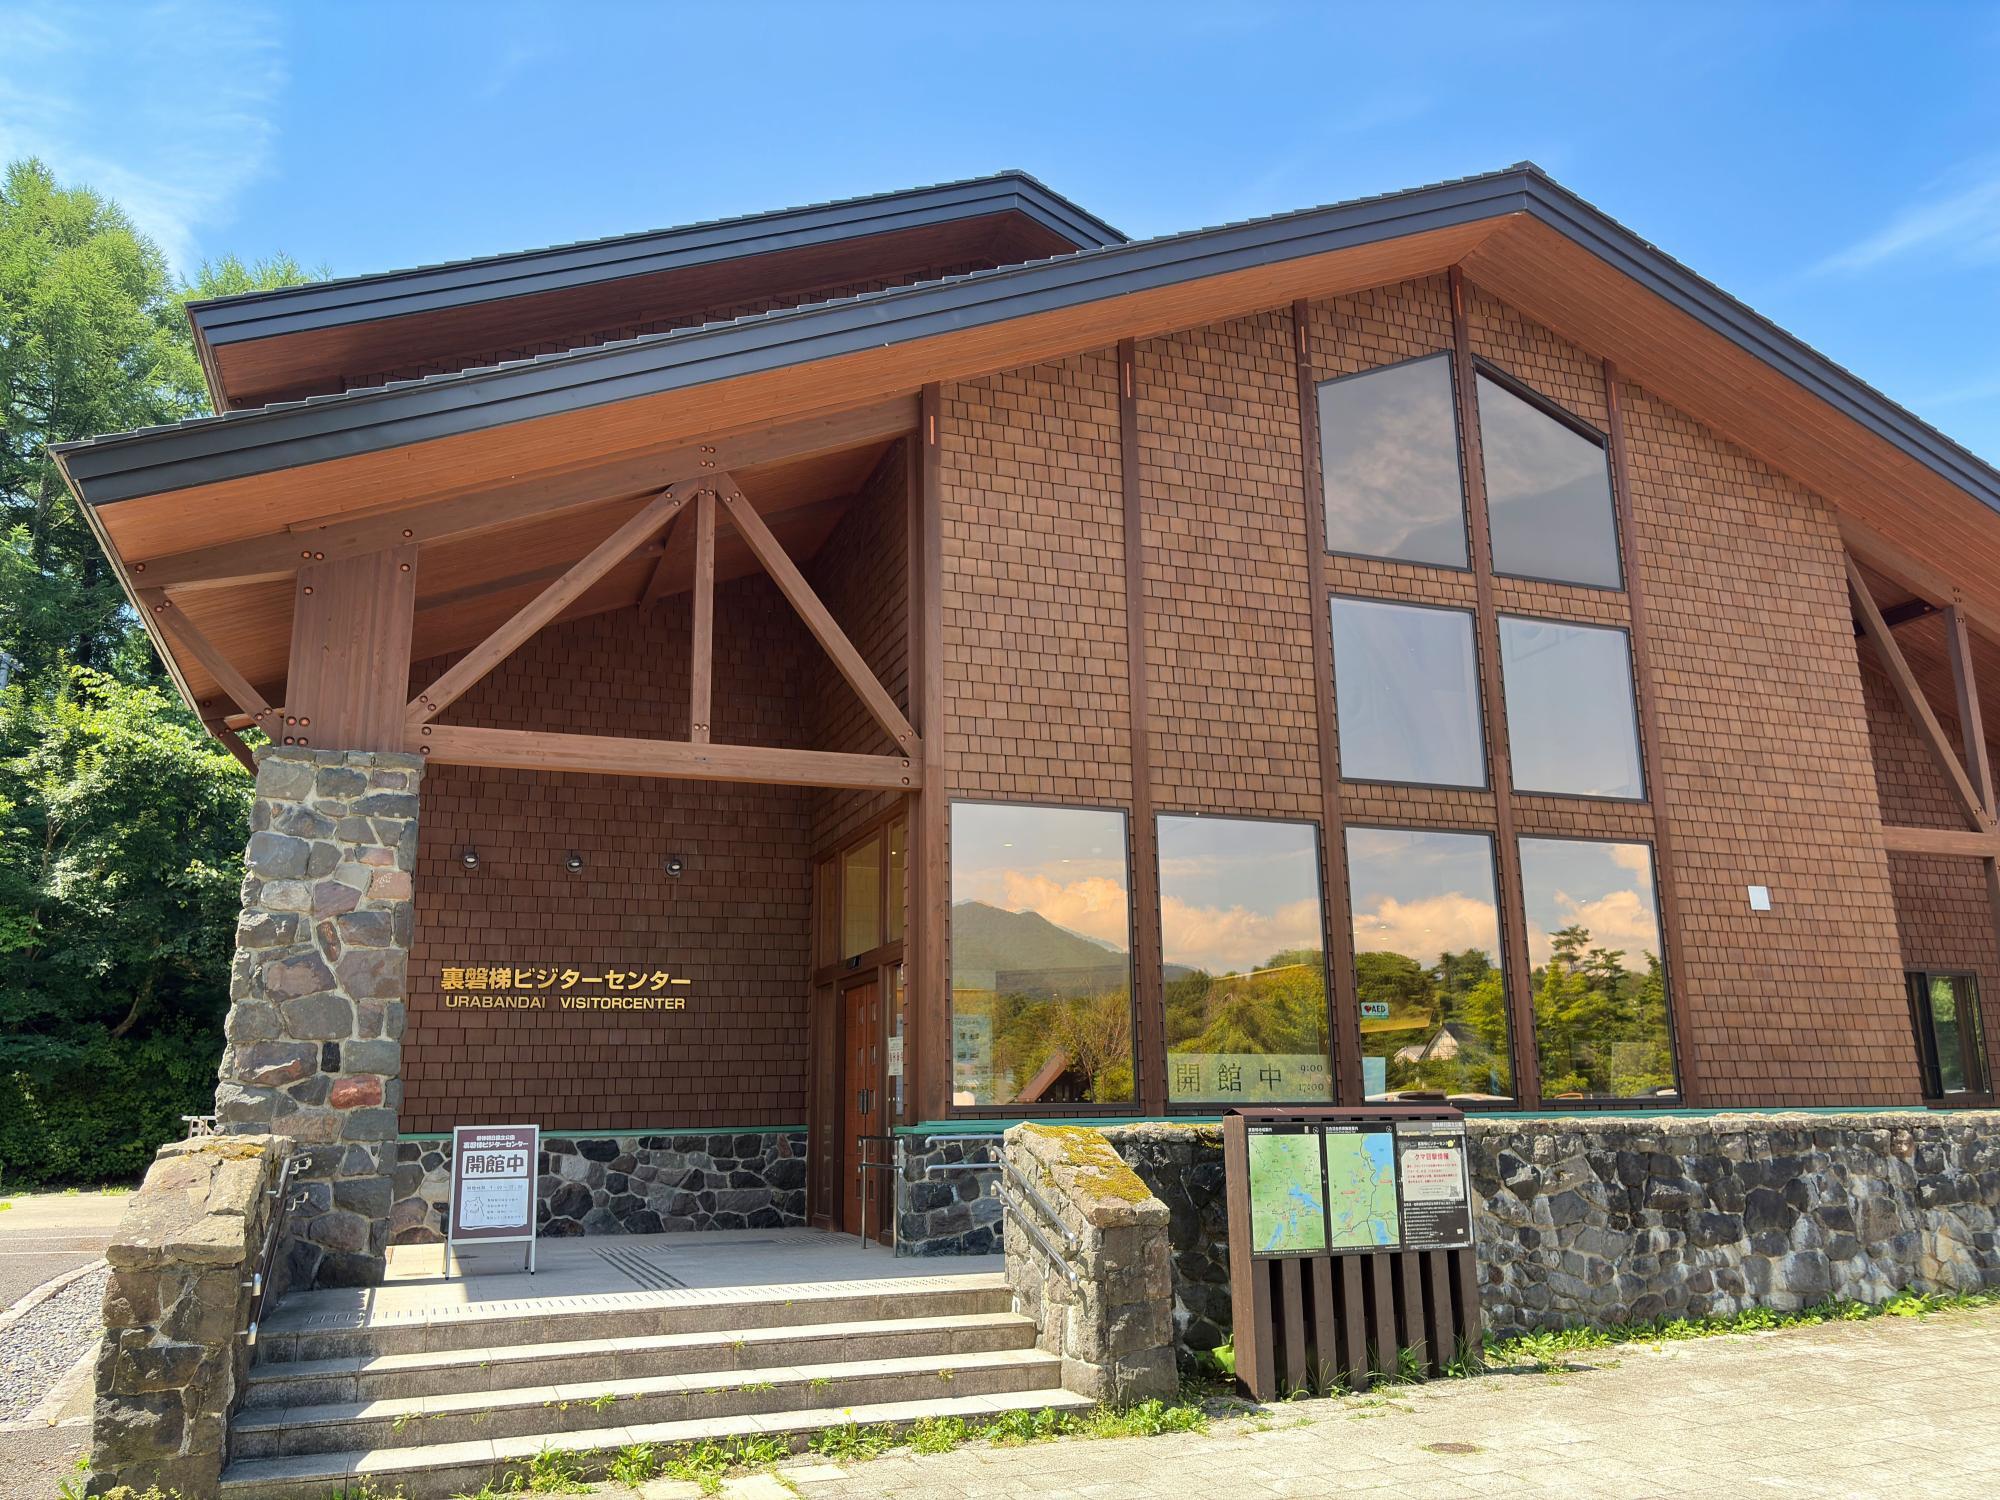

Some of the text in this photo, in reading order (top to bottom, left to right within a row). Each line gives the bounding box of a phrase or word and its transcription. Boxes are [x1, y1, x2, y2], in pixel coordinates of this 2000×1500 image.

[440, 967, 692, 991] 裏磐梯ビジターセンター
[445, 995, 686, 1010] URABANDAI VISITORCENTER
[1371, 1005, 1386, 1013] AED
[1300, 1064, 1323, 1073] 9:00
[1176, 1063, 1282, 1093] 開館中
[1298, 1083, 1324, 1092] 17:00
[463, 1140, 529, 1149] ビジターセンター
[465, 1154, 524, 1174] 開館中
